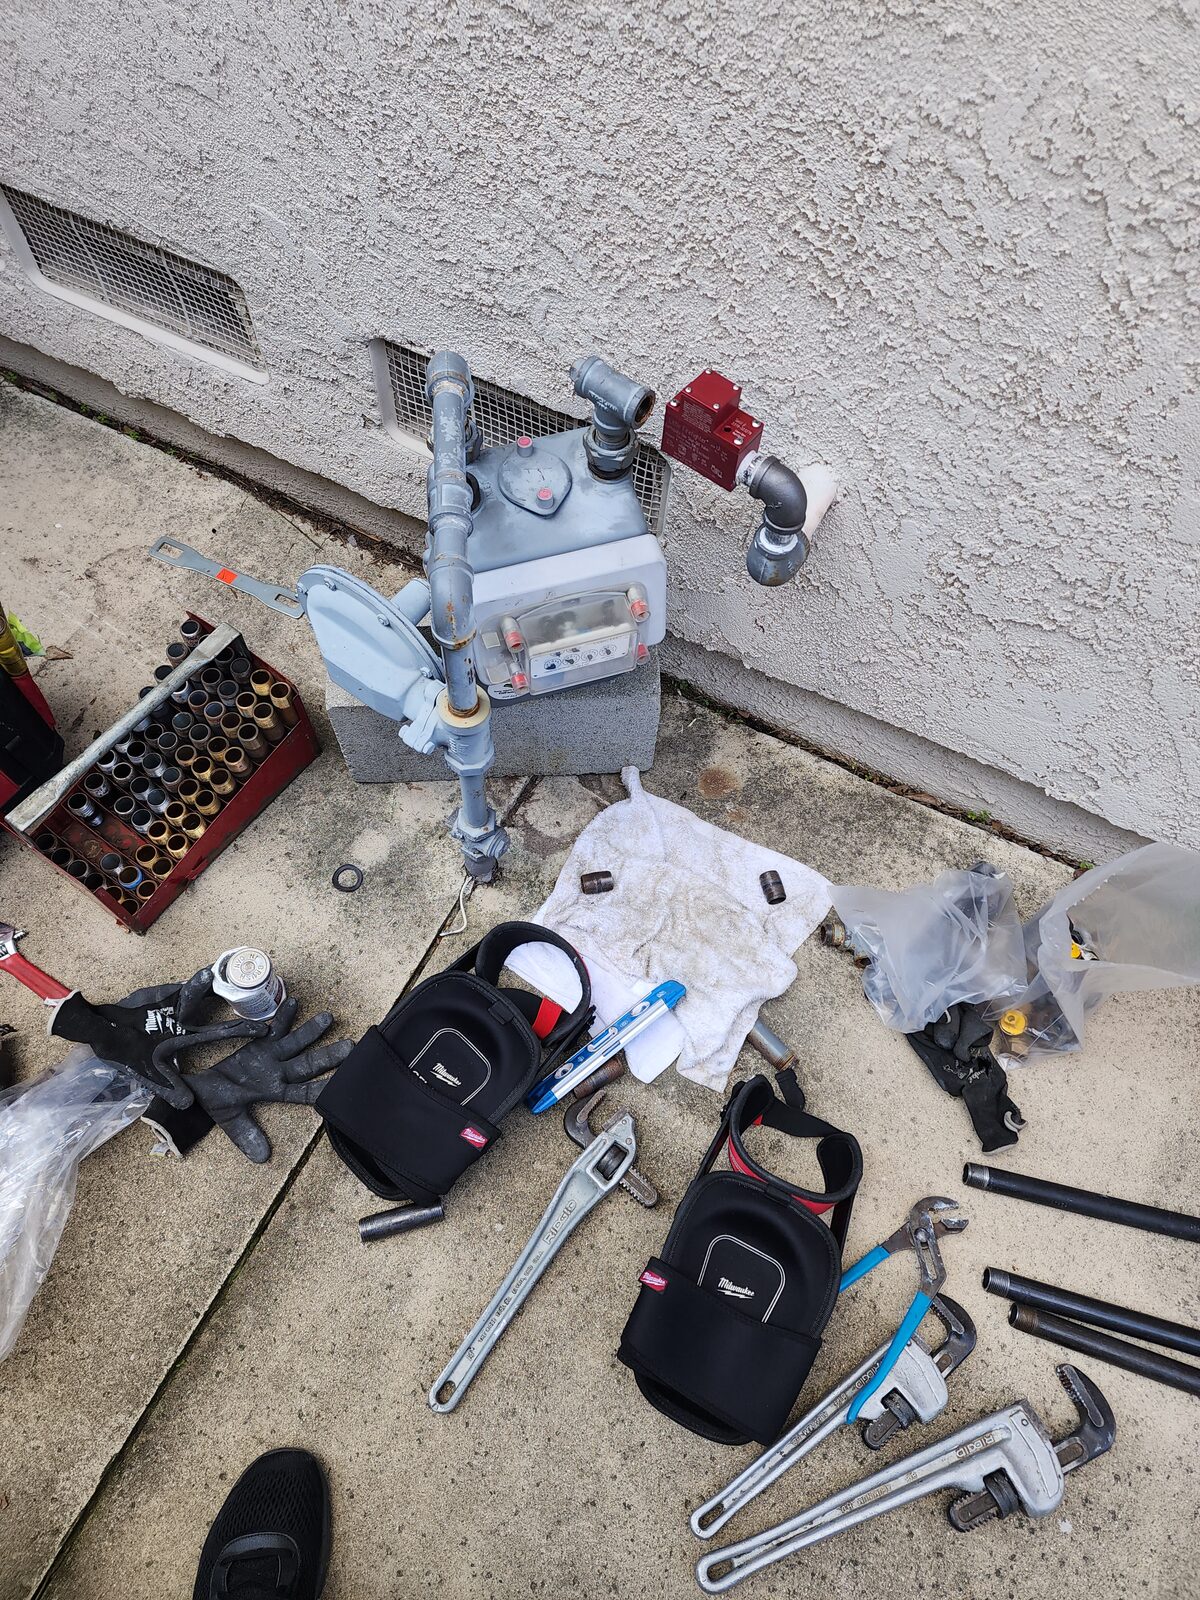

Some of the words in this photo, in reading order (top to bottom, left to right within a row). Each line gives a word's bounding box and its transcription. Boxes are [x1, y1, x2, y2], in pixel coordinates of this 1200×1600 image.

[432, 1062, 462, 1086] Milwaukee
[542, 1200, 576, 1245] RIDGID
[717, 1277, 755, 1297] Milwaukee
[956, 1434, 995, 1458] RIDGID
